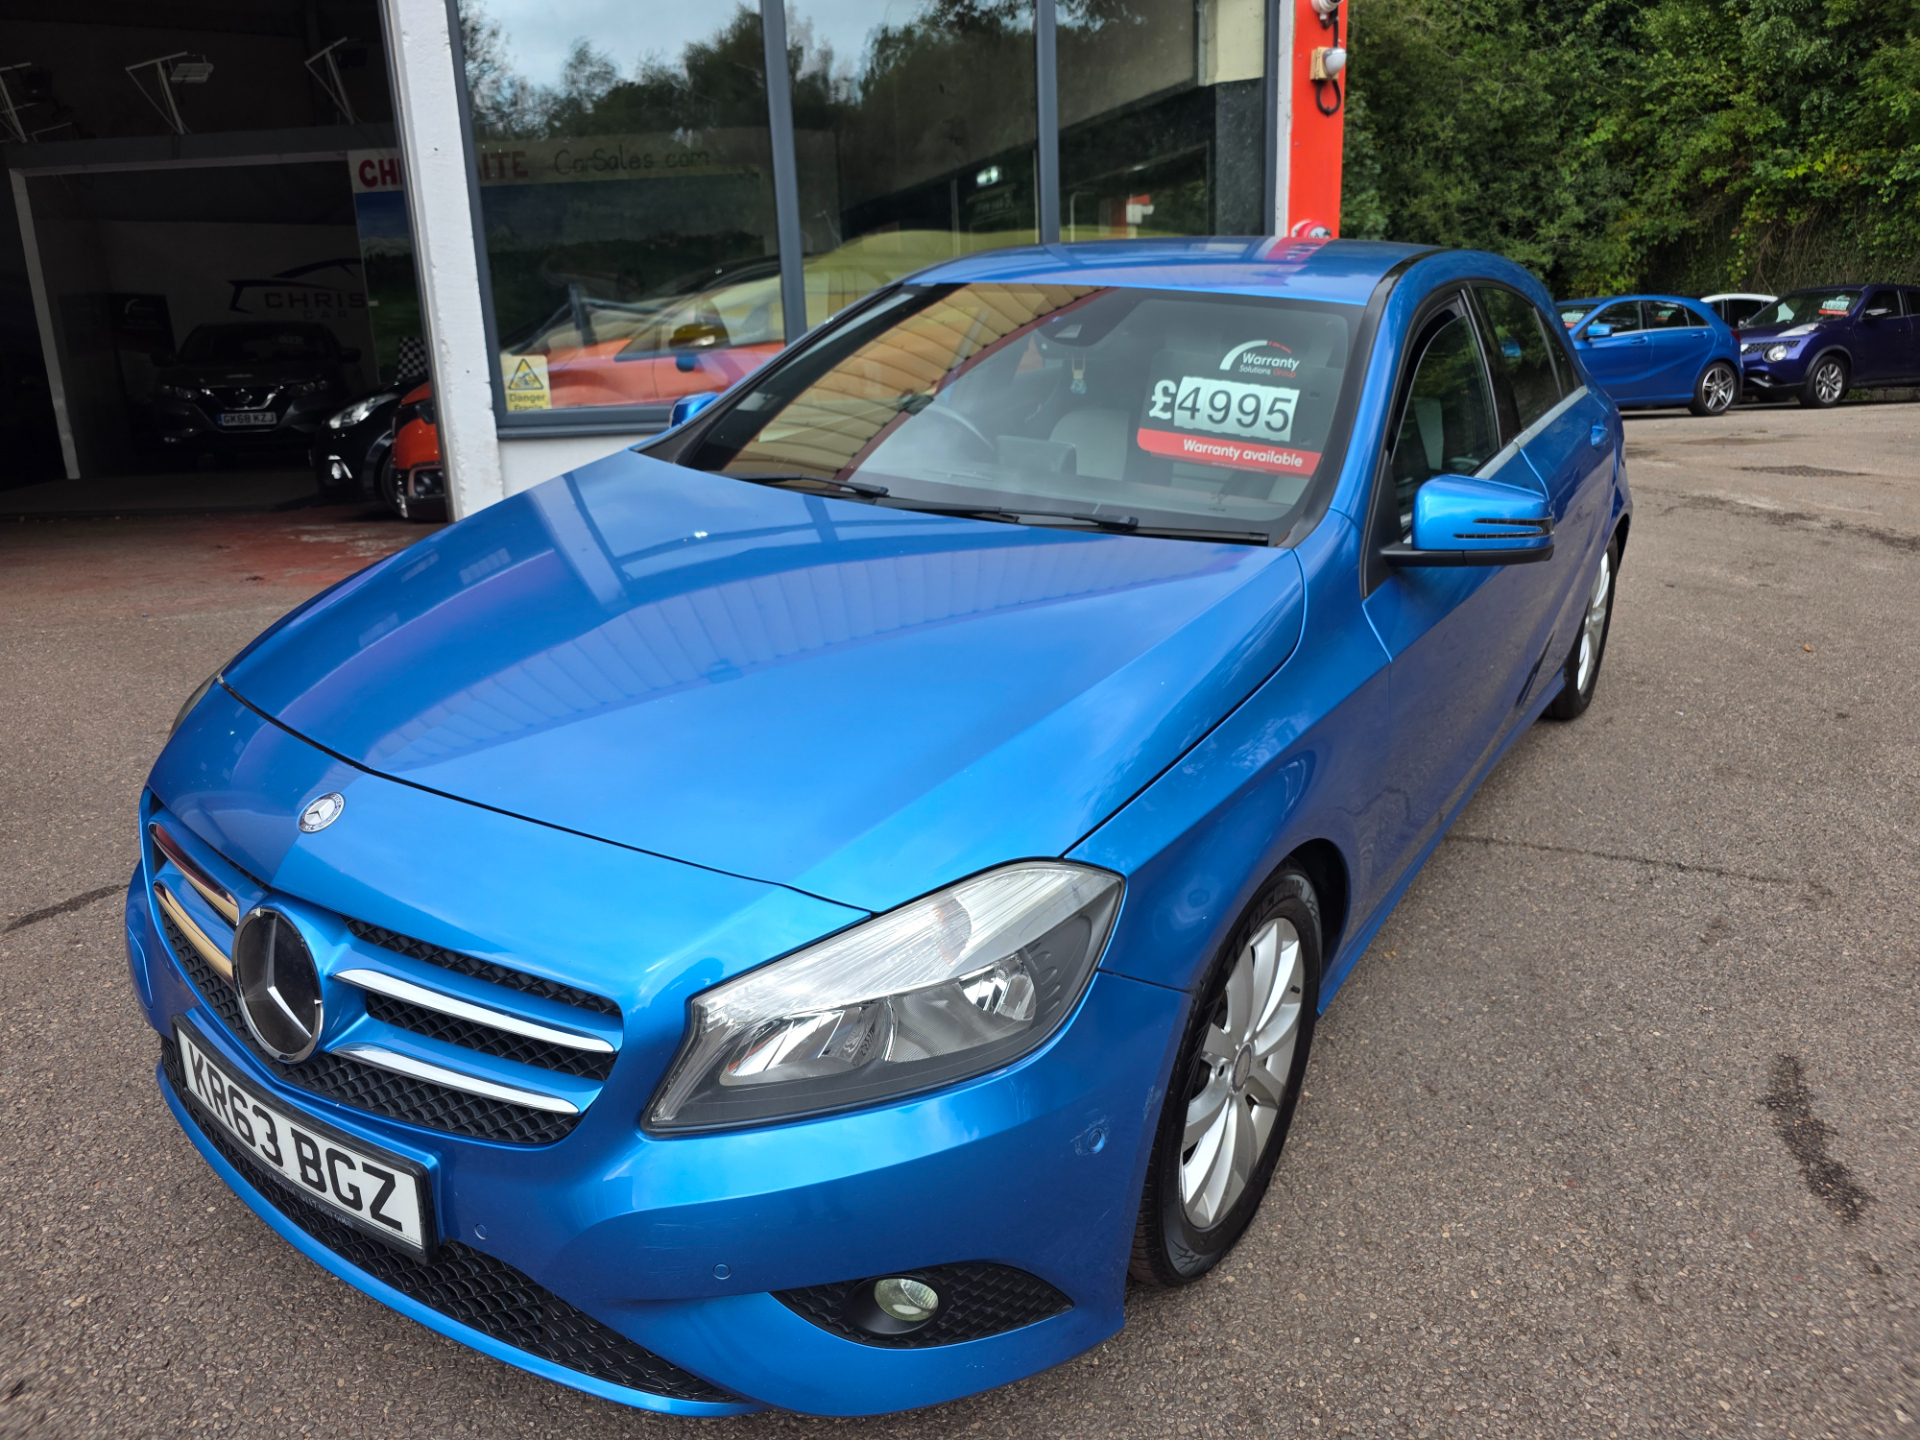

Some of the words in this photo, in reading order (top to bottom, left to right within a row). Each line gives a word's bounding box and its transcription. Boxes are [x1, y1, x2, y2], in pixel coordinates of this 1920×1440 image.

[359, 158, 403, 188] CH
[477, 150, 529, 181] ITE
[264, 292, 368, 309] CHRIS
[303, 310, 349, 320] CAR
[1239, 364, 1271, 376] Solutions
[1272, 367, 1298, 379] Group
[1242, 352, 1300, 372] Warranty
[509, 393, 545, 403] Danger
[1148, 379, 1293, 434] £4995
[1183, 439, 1241, 460] Warranty
[1243, 450, 1304, 468] available
[188, 1041, 284, 1168] KR63
[290, 1126, 403, 1233] BGZ
